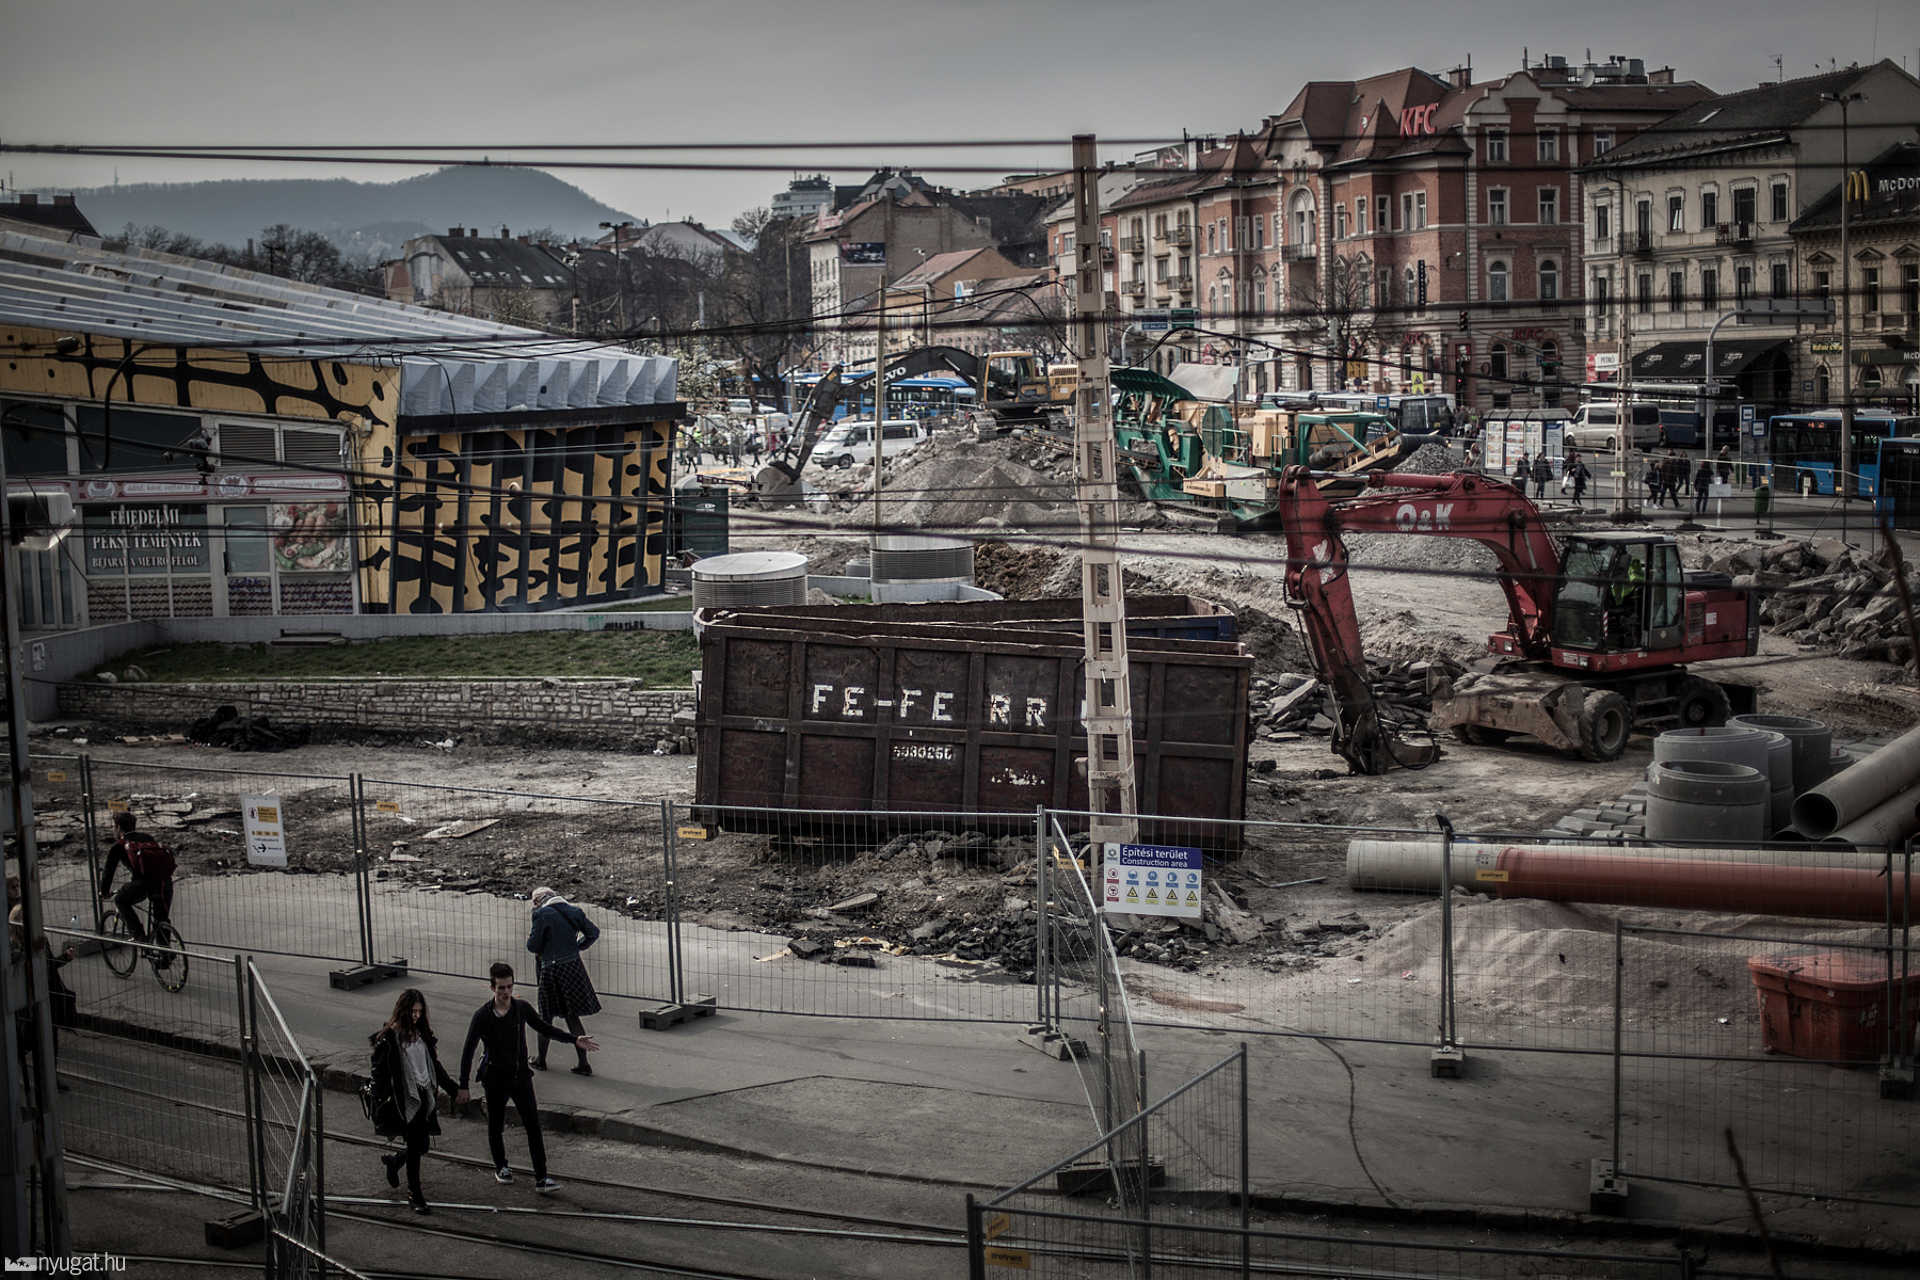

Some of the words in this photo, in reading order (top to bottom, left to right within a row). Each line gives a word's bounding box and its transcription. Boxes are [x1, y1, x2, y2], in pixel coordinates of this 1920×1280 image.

[1399, 102, 1439, 137] KFC
[1396, 503, 1455, 531] O&K
[1122, 857, 1169, 867] Construction
[1155, 849, 1188, 860] terület
